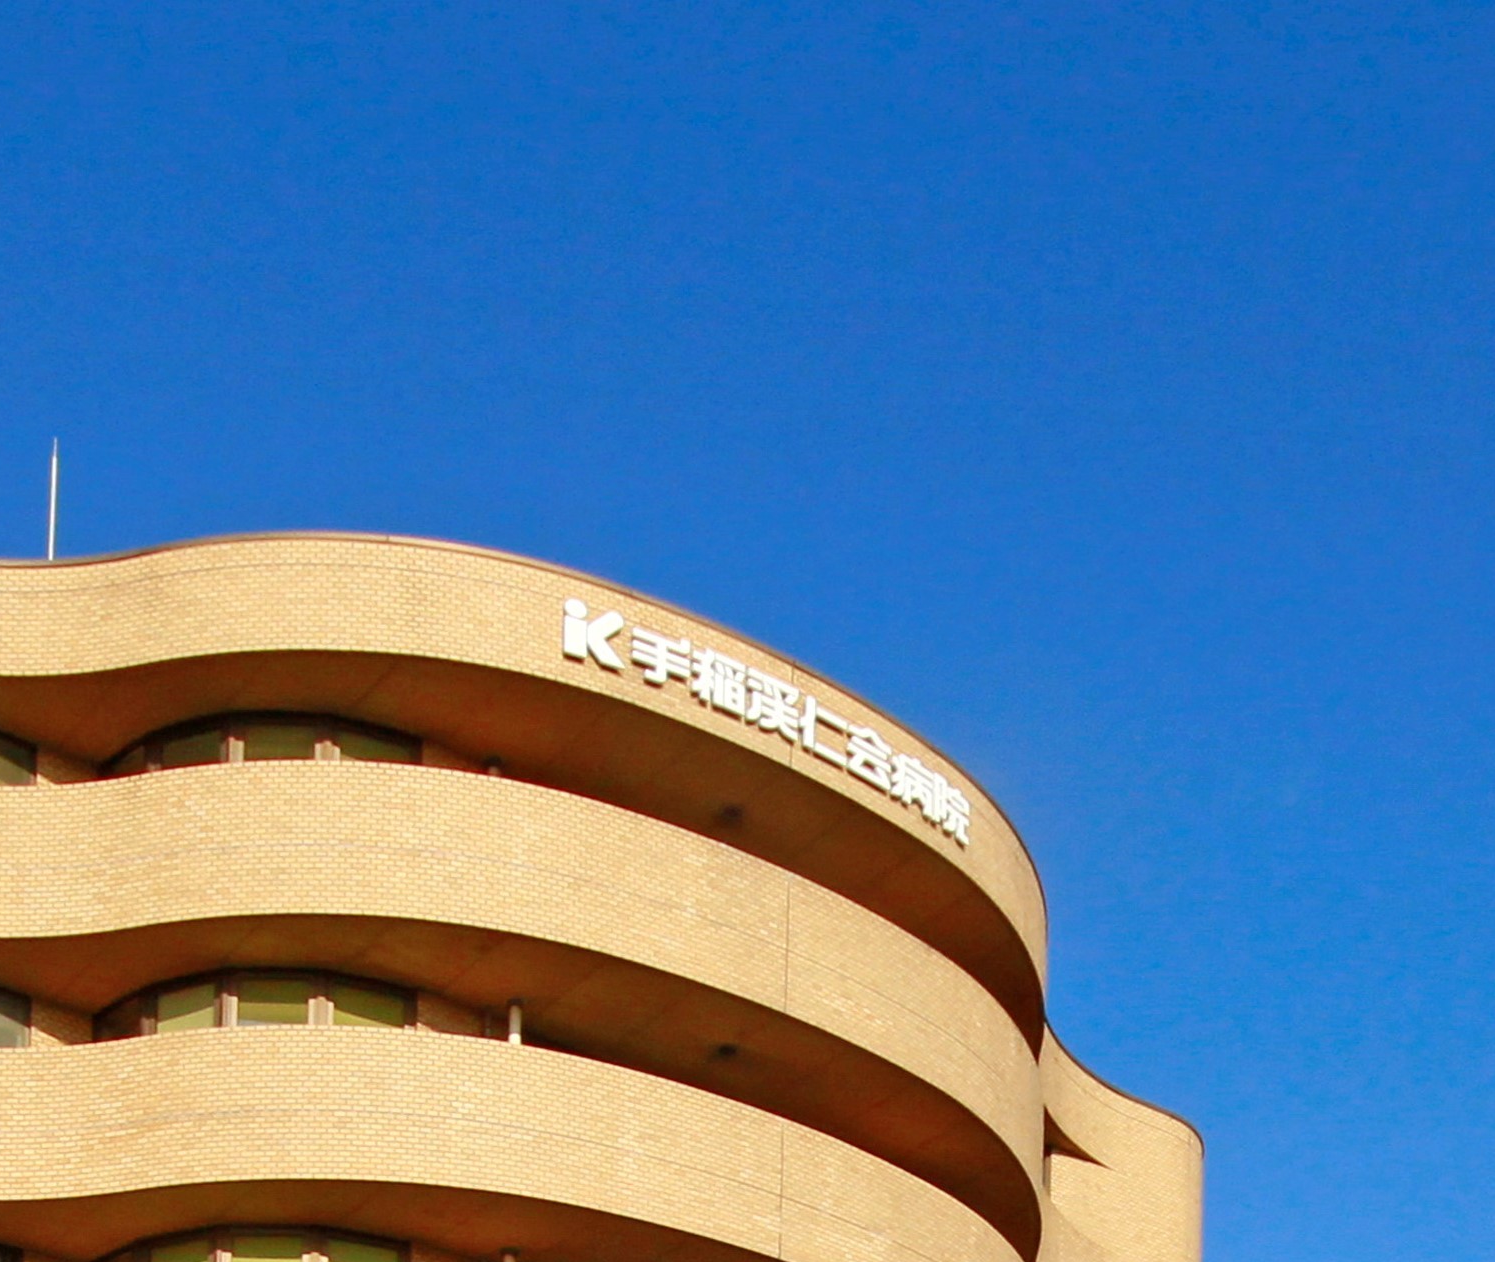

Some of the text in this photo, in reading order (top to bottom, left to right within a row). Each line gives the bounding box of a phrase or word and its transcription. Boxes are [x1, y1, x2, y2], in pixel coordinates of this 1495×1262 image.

[631, 627, 971, 845] 手稲渓仁会病院
